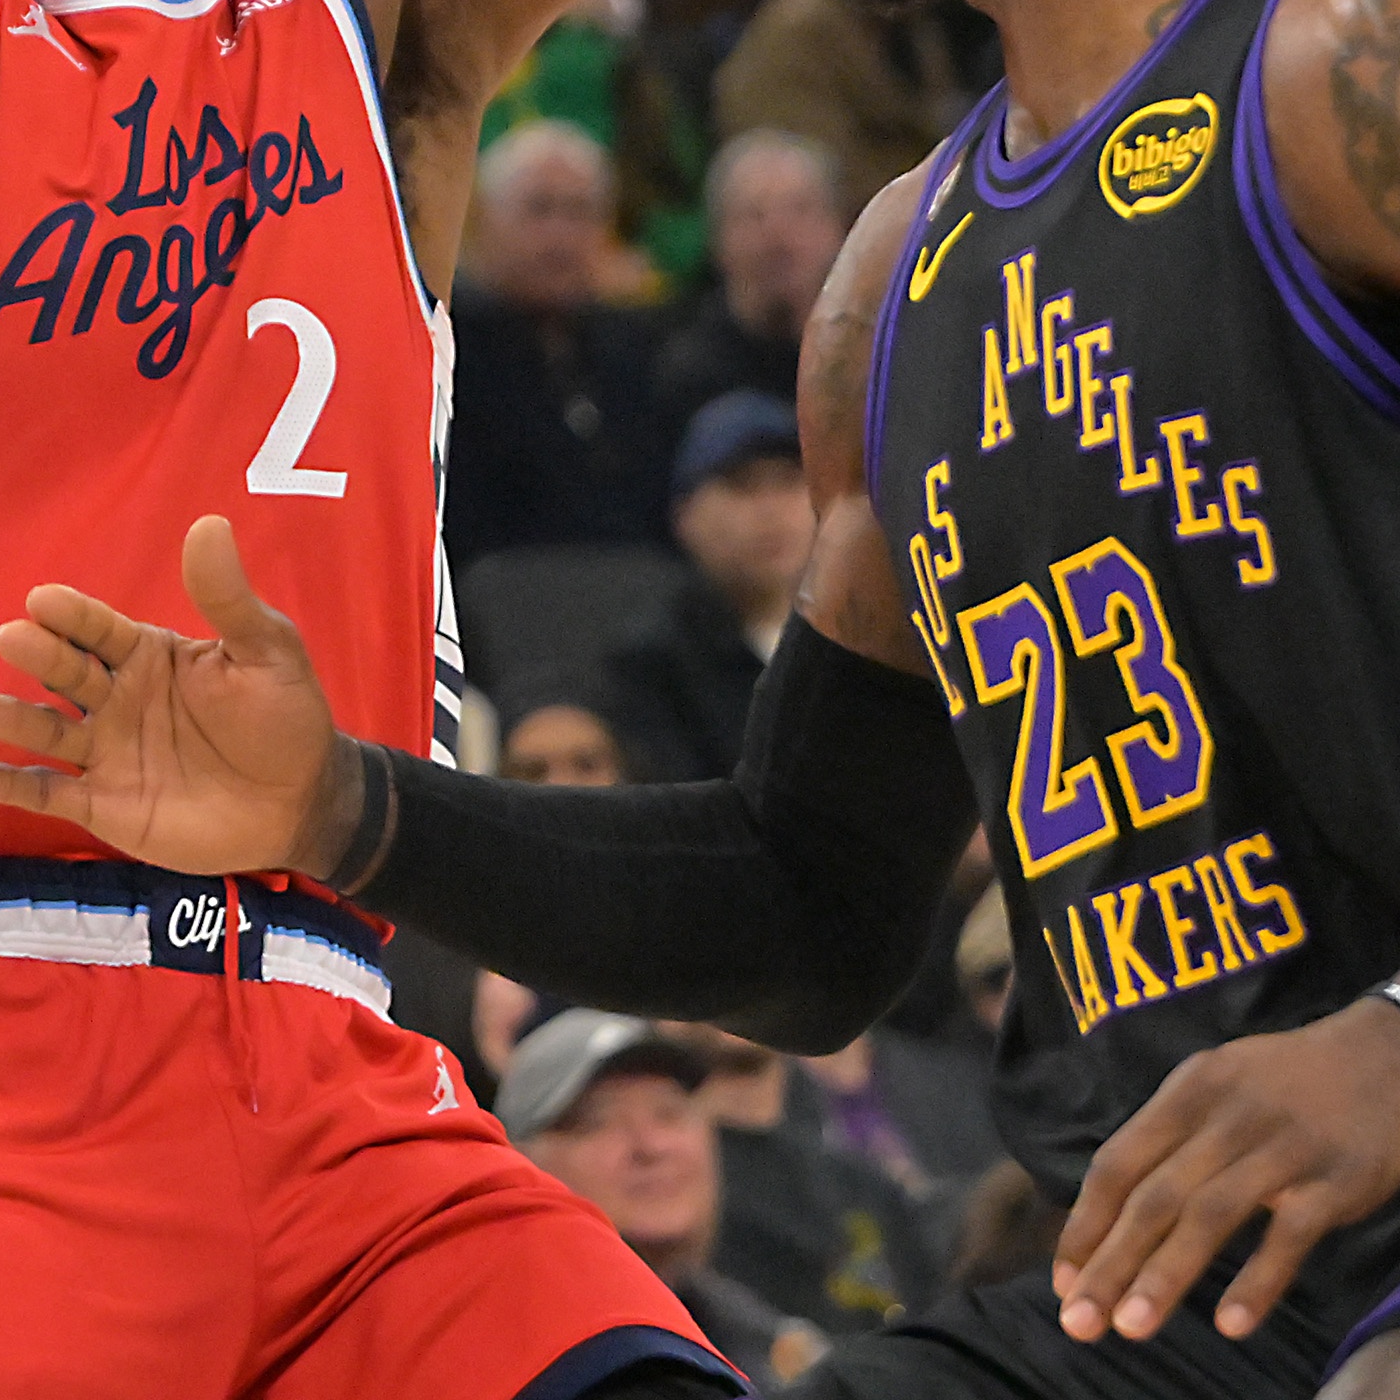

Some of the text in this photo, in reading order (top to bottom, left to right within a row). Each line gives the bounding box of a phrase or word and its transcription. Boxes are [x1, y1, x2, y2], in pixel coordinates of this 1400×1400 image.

[106, 77, 248, 216] Los
[1112, 126, 1210, 177] bibigo
[246, 297, 348, 499] 2
[980, 250, 1277, 586] ANGELES
[955, 535, 1215, 881] 23
